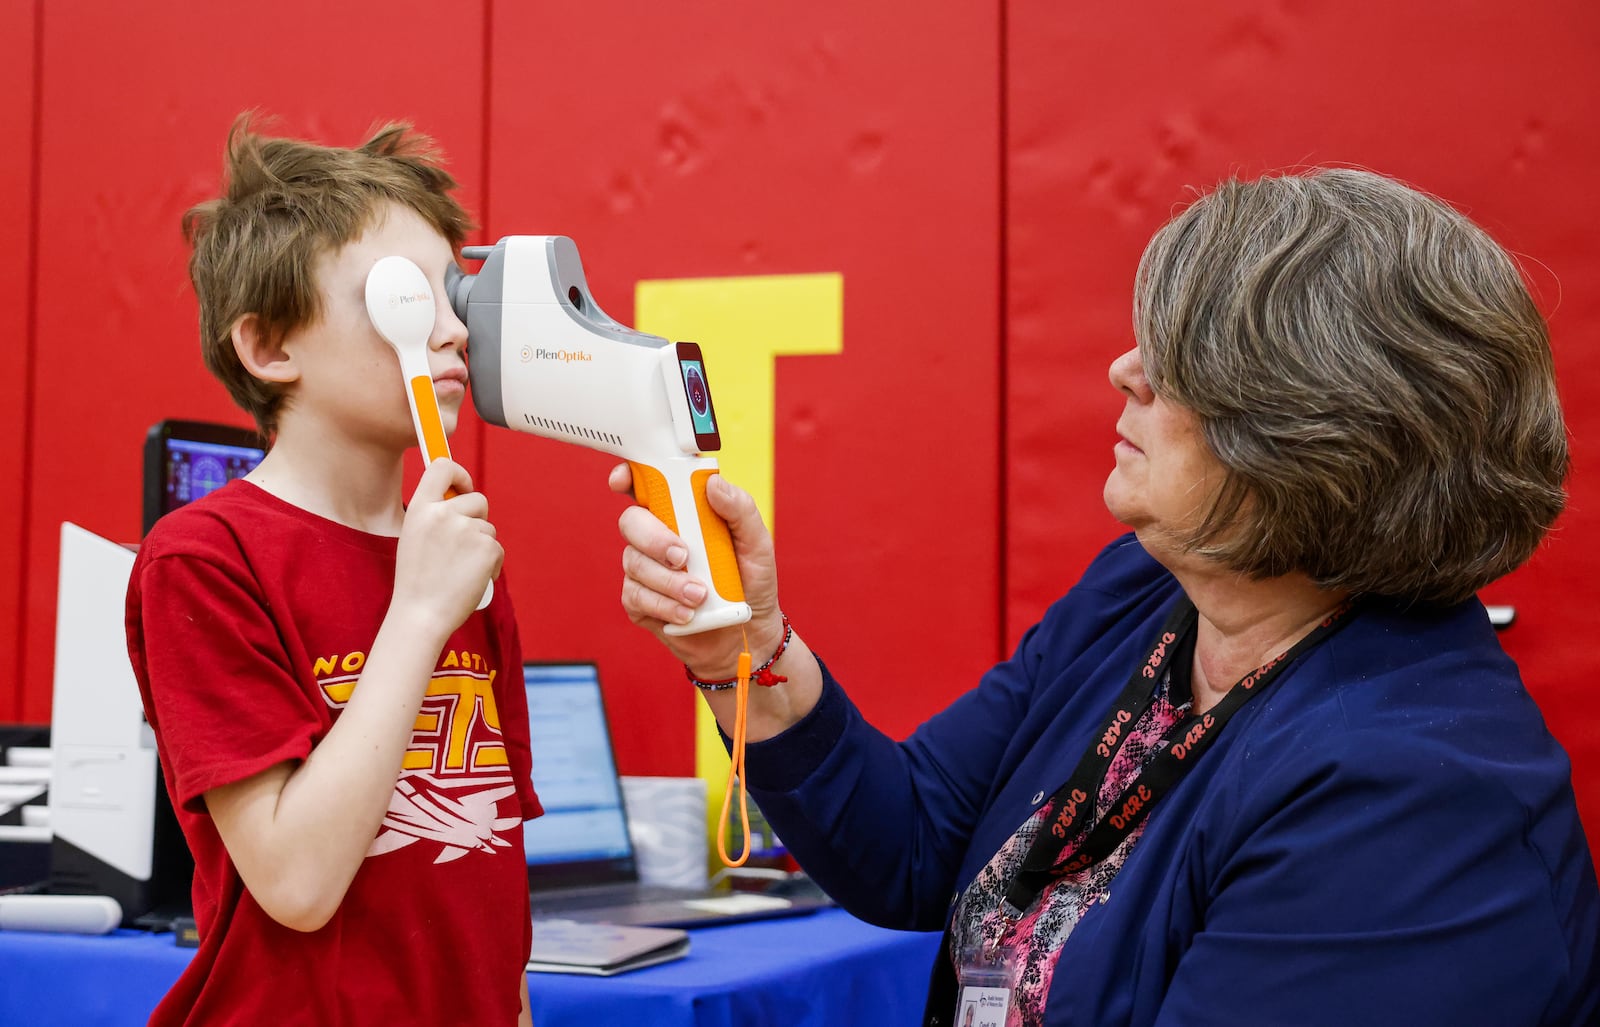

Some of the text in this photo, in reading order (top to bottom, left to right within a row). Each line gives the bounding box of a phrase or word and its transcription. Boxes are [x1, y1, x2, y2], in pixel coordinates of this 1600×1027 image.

[536, 348, 592, 363] PlenOptika
[1142, 632, 1176, 678] DARE
[1097, 710, 1132, 757] DARE
[1171, 714, 1216, 760] DARE
[1052, 788, 1086, 838] DARE
[1110, 785, 1152, 830] DARE
